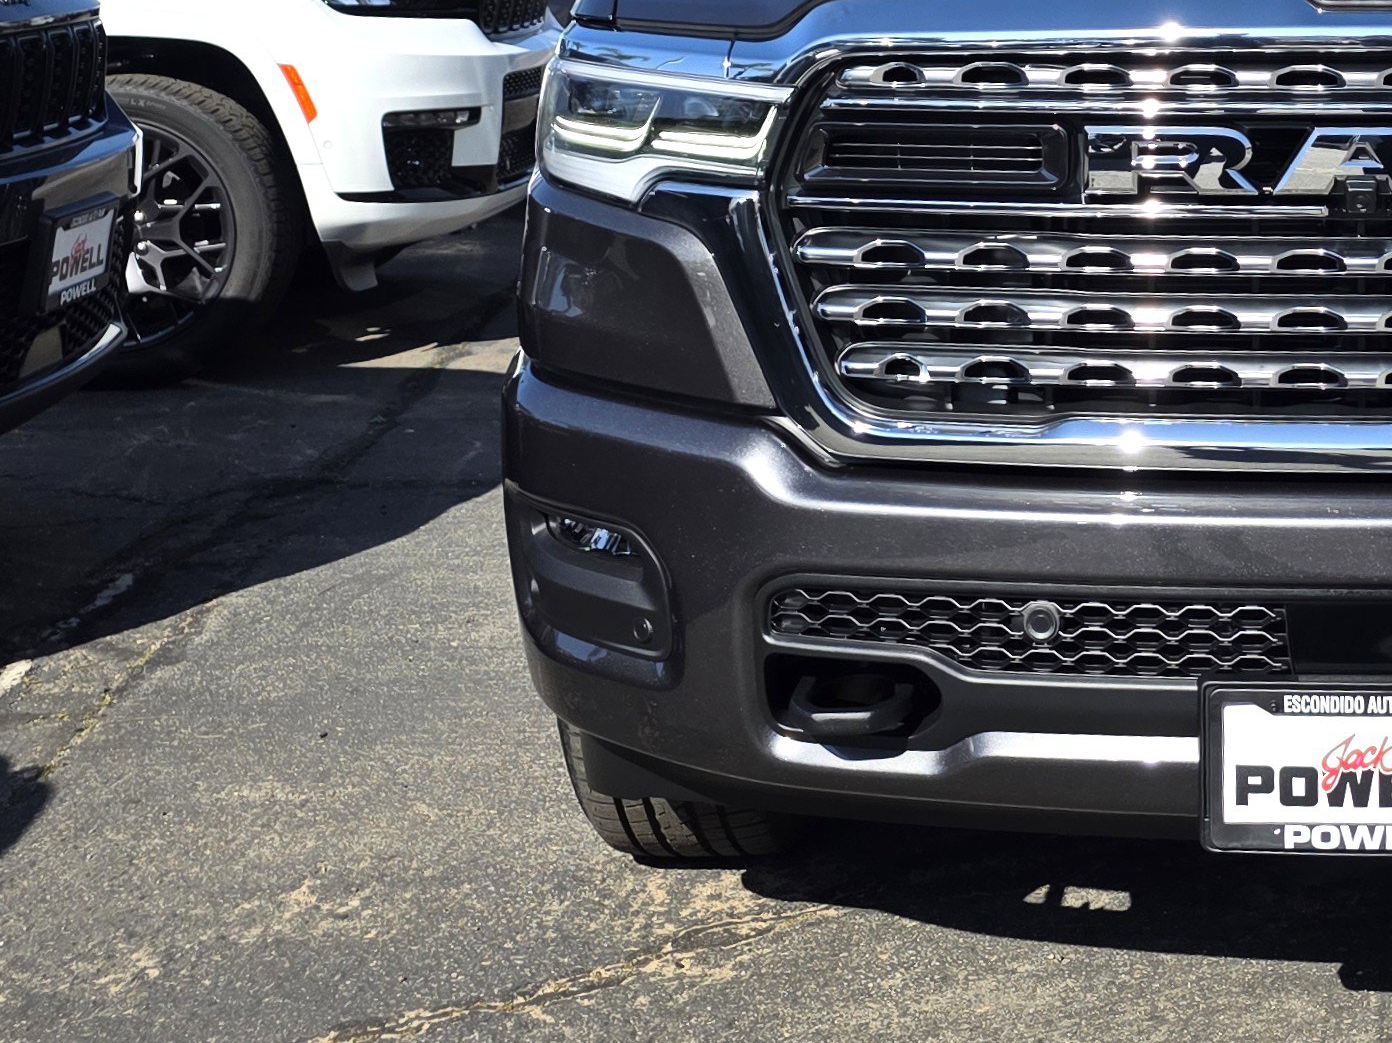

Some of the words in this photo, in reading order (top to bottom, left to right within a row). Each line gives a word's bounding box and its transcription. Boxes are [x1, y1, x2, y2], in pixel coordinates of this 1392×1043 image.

[52, 243, 104, 282] POWELL
[60, 278, 97, 306] POWELL
[1283, 694, 1365, 714] ESCONDIDO
